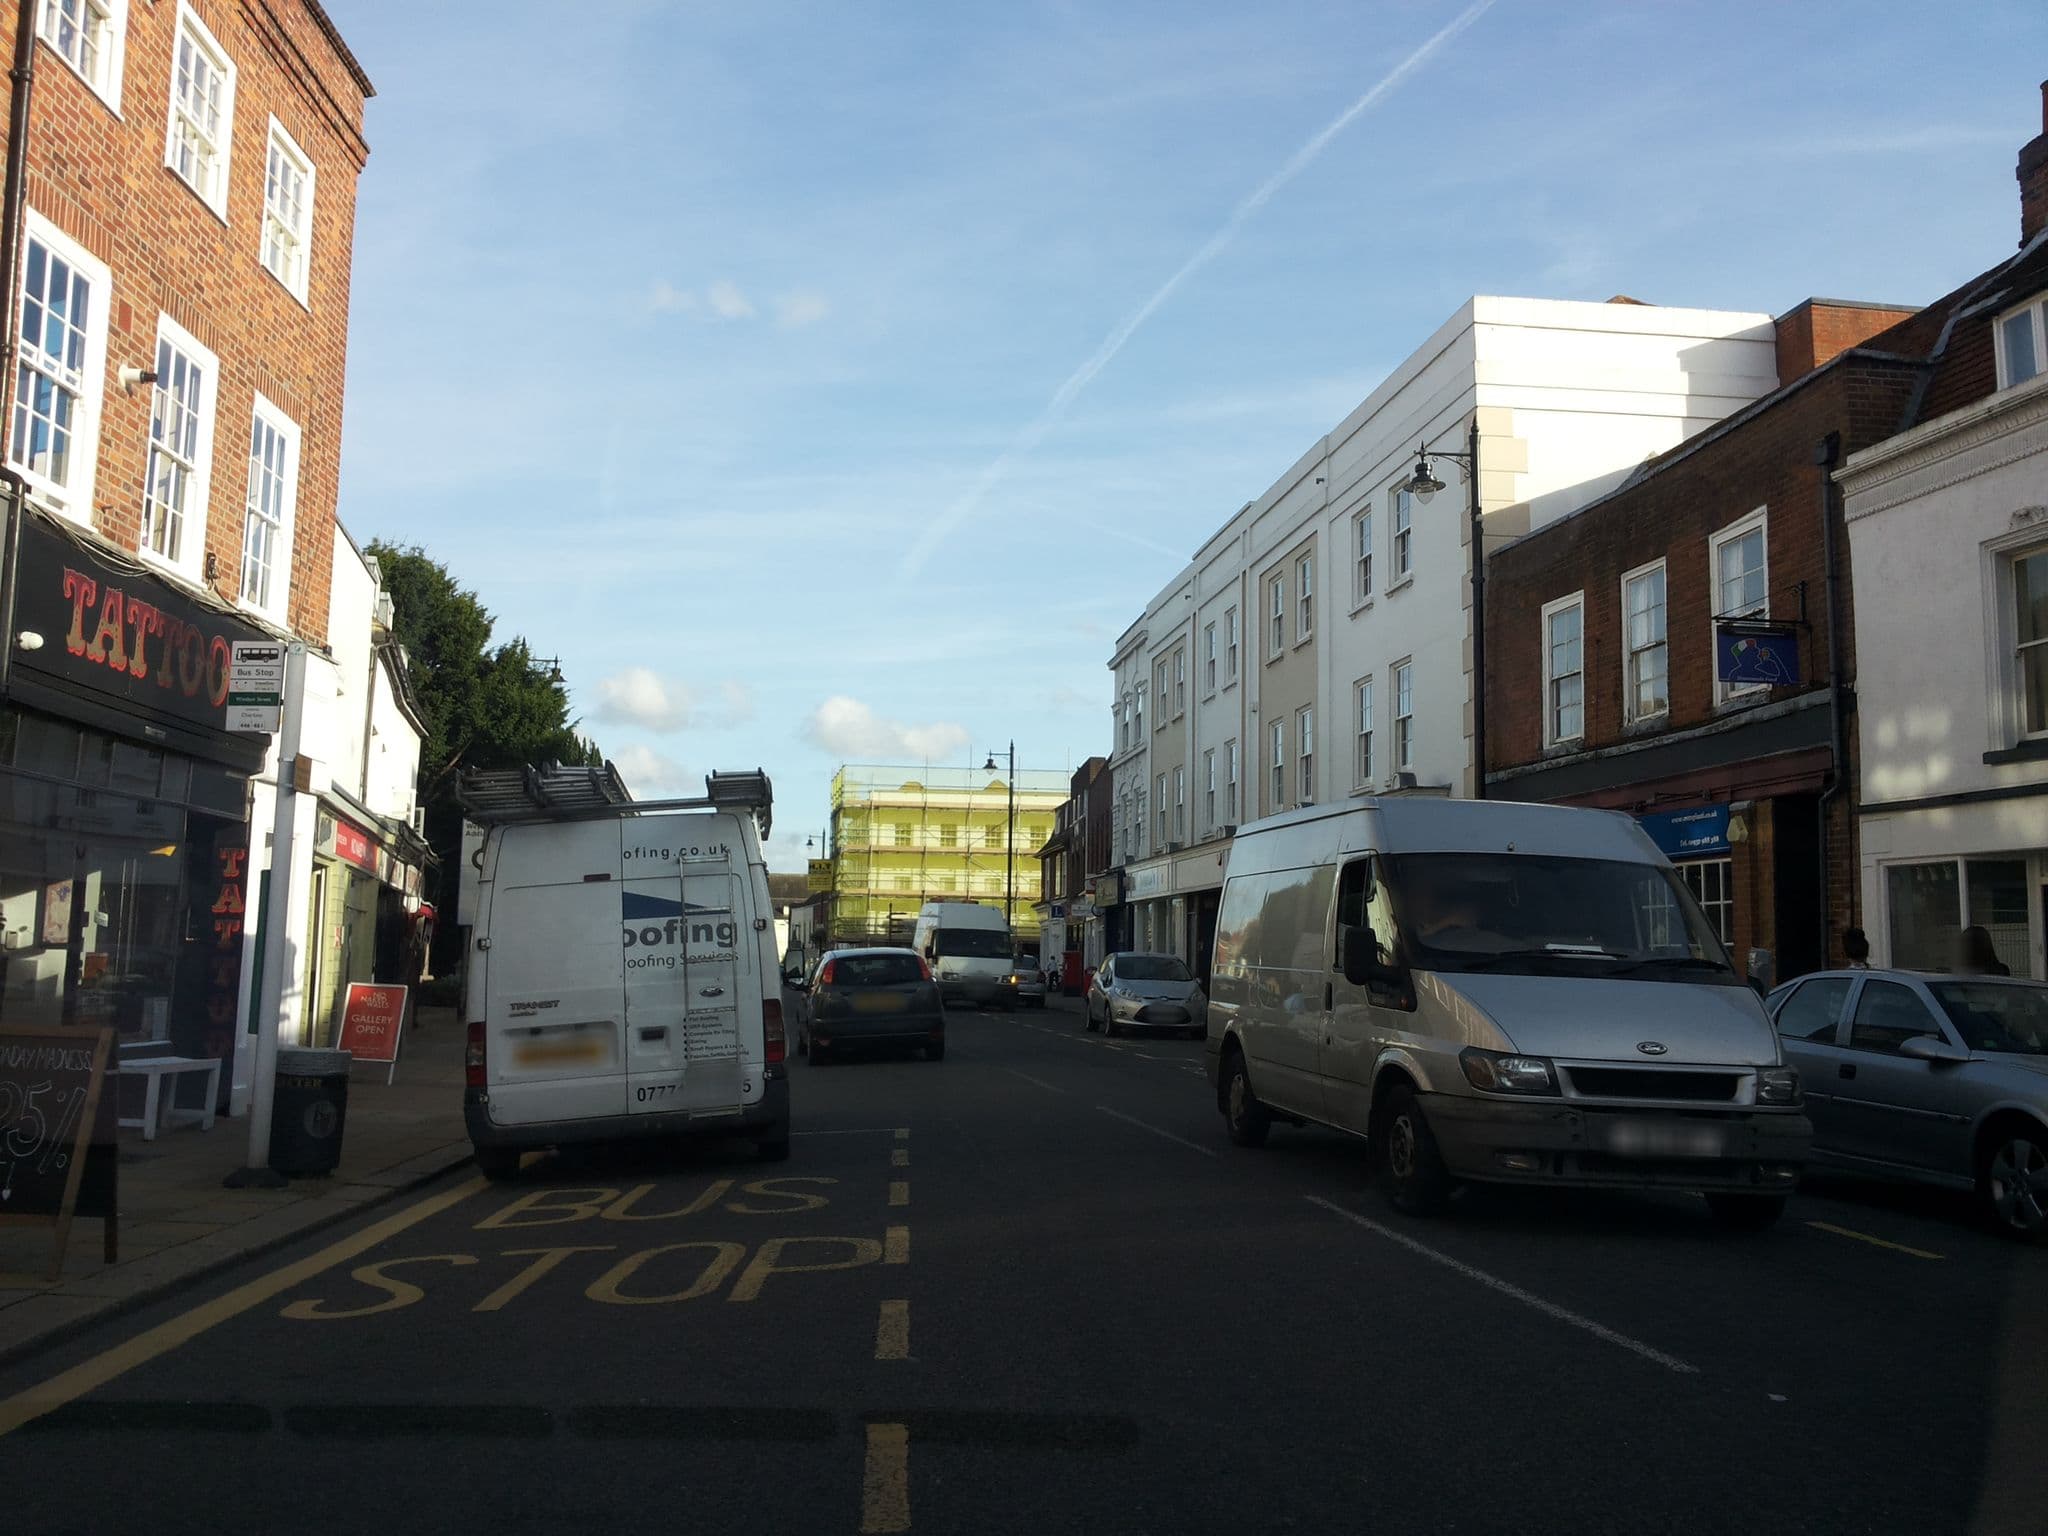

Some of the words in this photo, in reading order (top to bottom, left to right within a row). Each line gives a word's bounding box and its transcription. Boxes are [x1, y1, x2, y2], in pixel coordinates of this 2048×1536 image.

[62, 566, 231, 708] TATTOO
[237, 668, 251, 676] Bus
[255, 668, 274, 678] Stop
[623, 842, 728, 860] ofing.co.uk
[624, 953, 677, 971] oofing
[351, 1014, 393, 1025] GALLERY
[356, 1025, 385, 1035] OPEN
[472, 1175, 840, 1230] BUS
[279, 1236, 885, 1321] STOP
